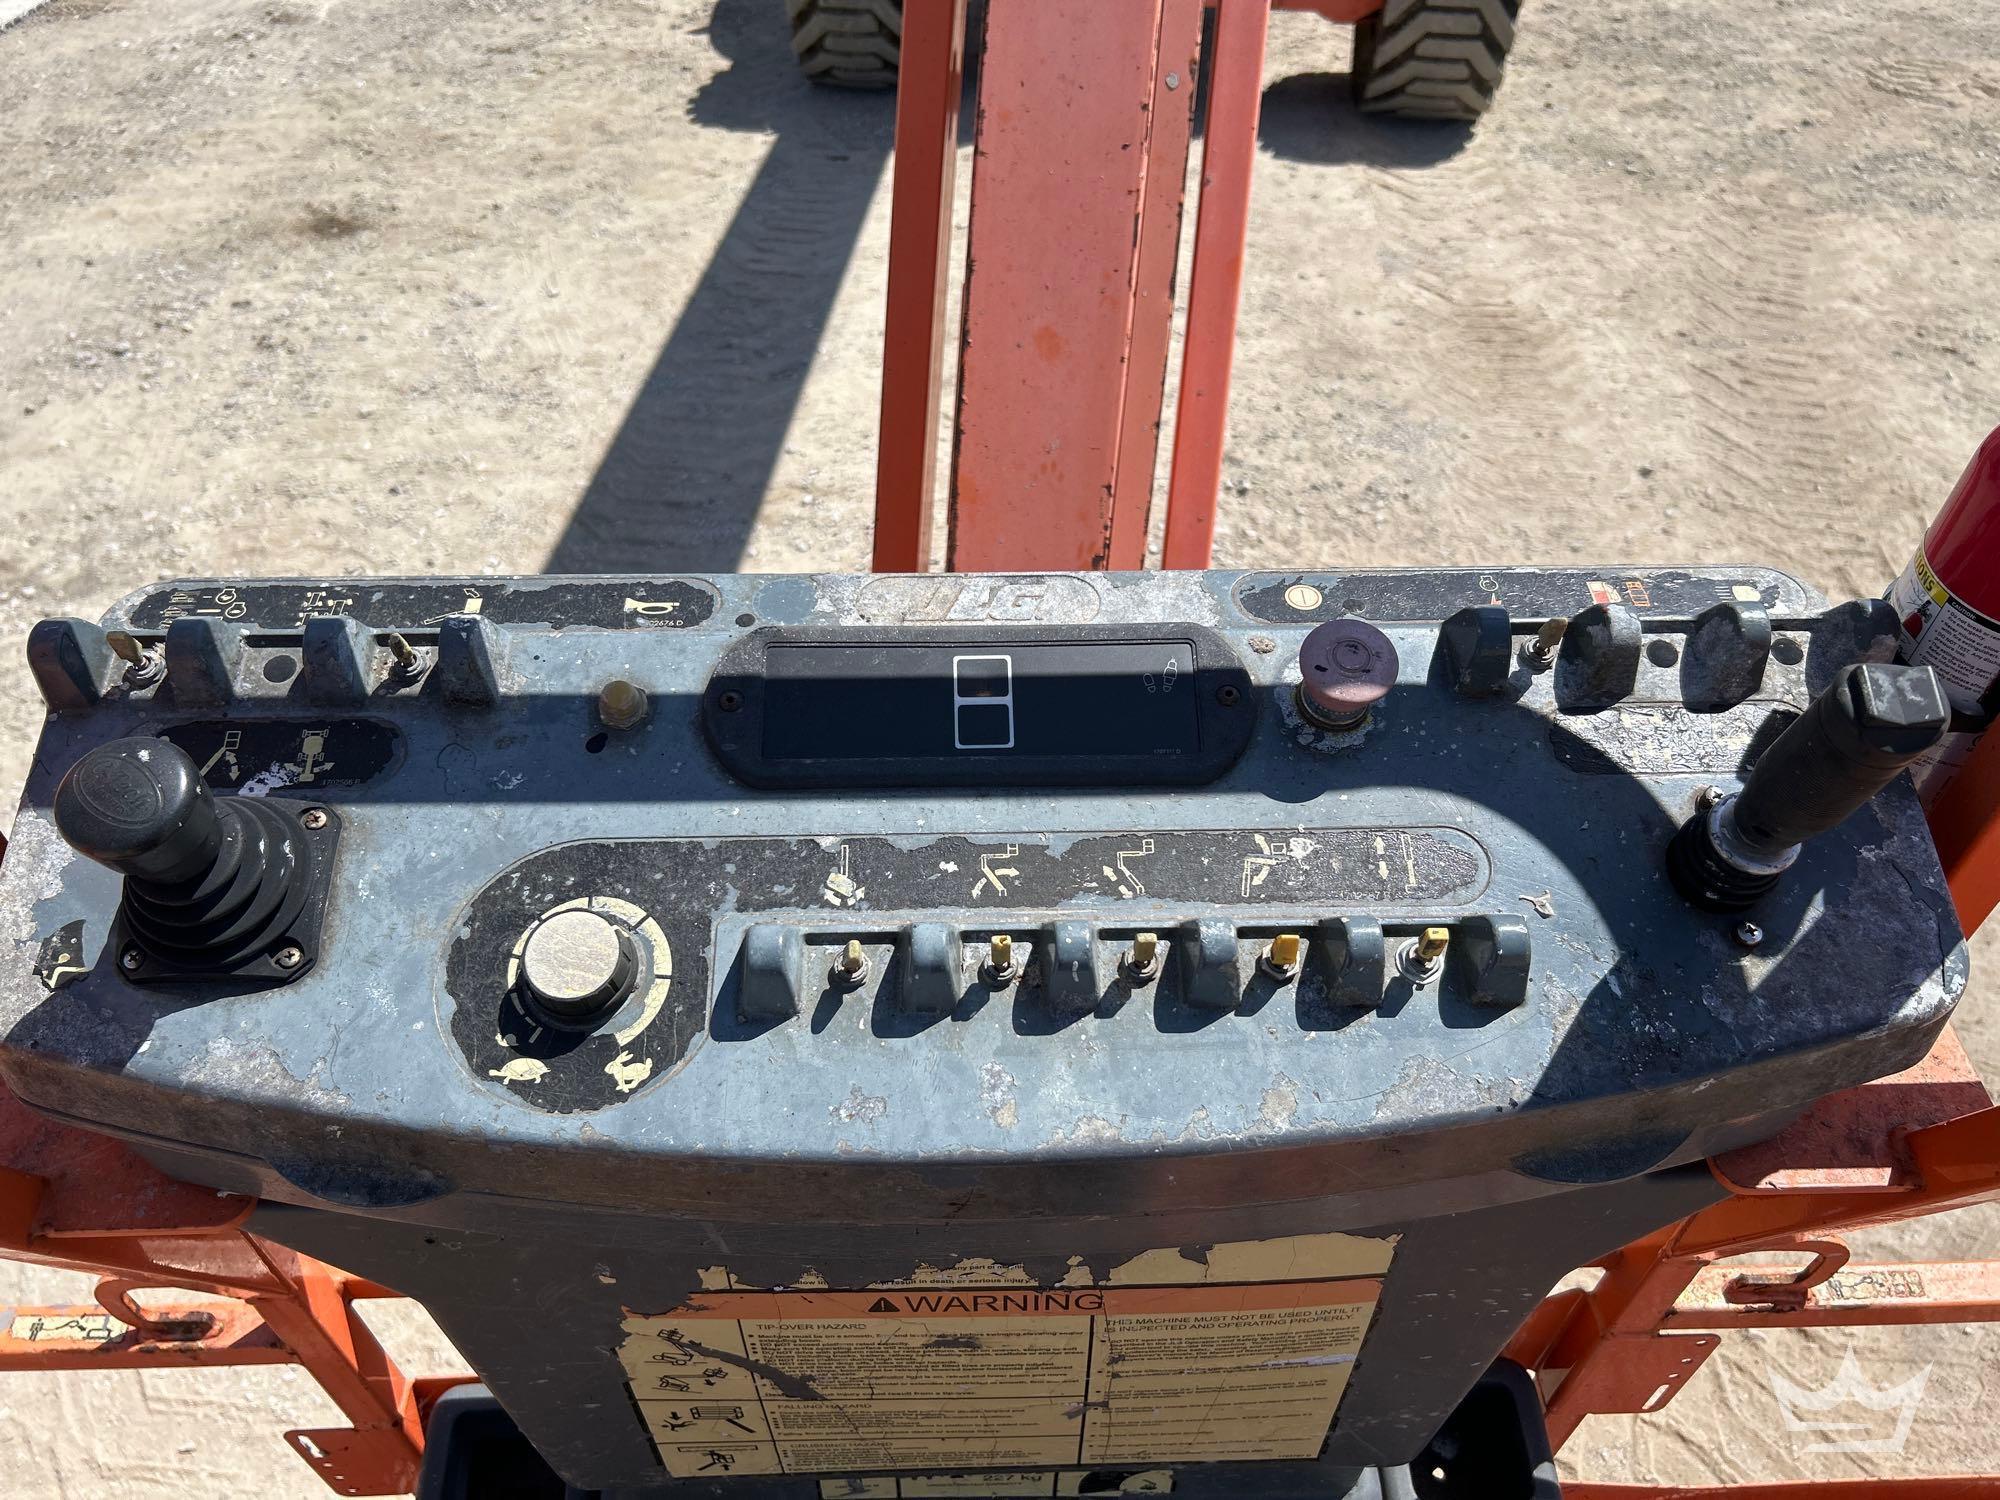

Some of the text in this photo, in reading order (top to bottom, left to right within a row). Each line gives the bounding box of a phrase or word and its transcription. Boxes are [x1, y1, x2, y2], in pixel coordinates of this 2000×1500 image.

[1958, 617, 1967, 625] not
[1946, 637, 1957, 646] NOT
[904, 1293, 1103, 1313] WARNING
[1136, 1317, 1191, 1325] MACHINE
[1194, 1315, 1228, 1323] MUST
[1314, 1308, 1348, 1316] UNTIL
[1119, 1324, 1187, 1332] INSPECTED
[1218, 1319, 1290, 1328] OPERATING
